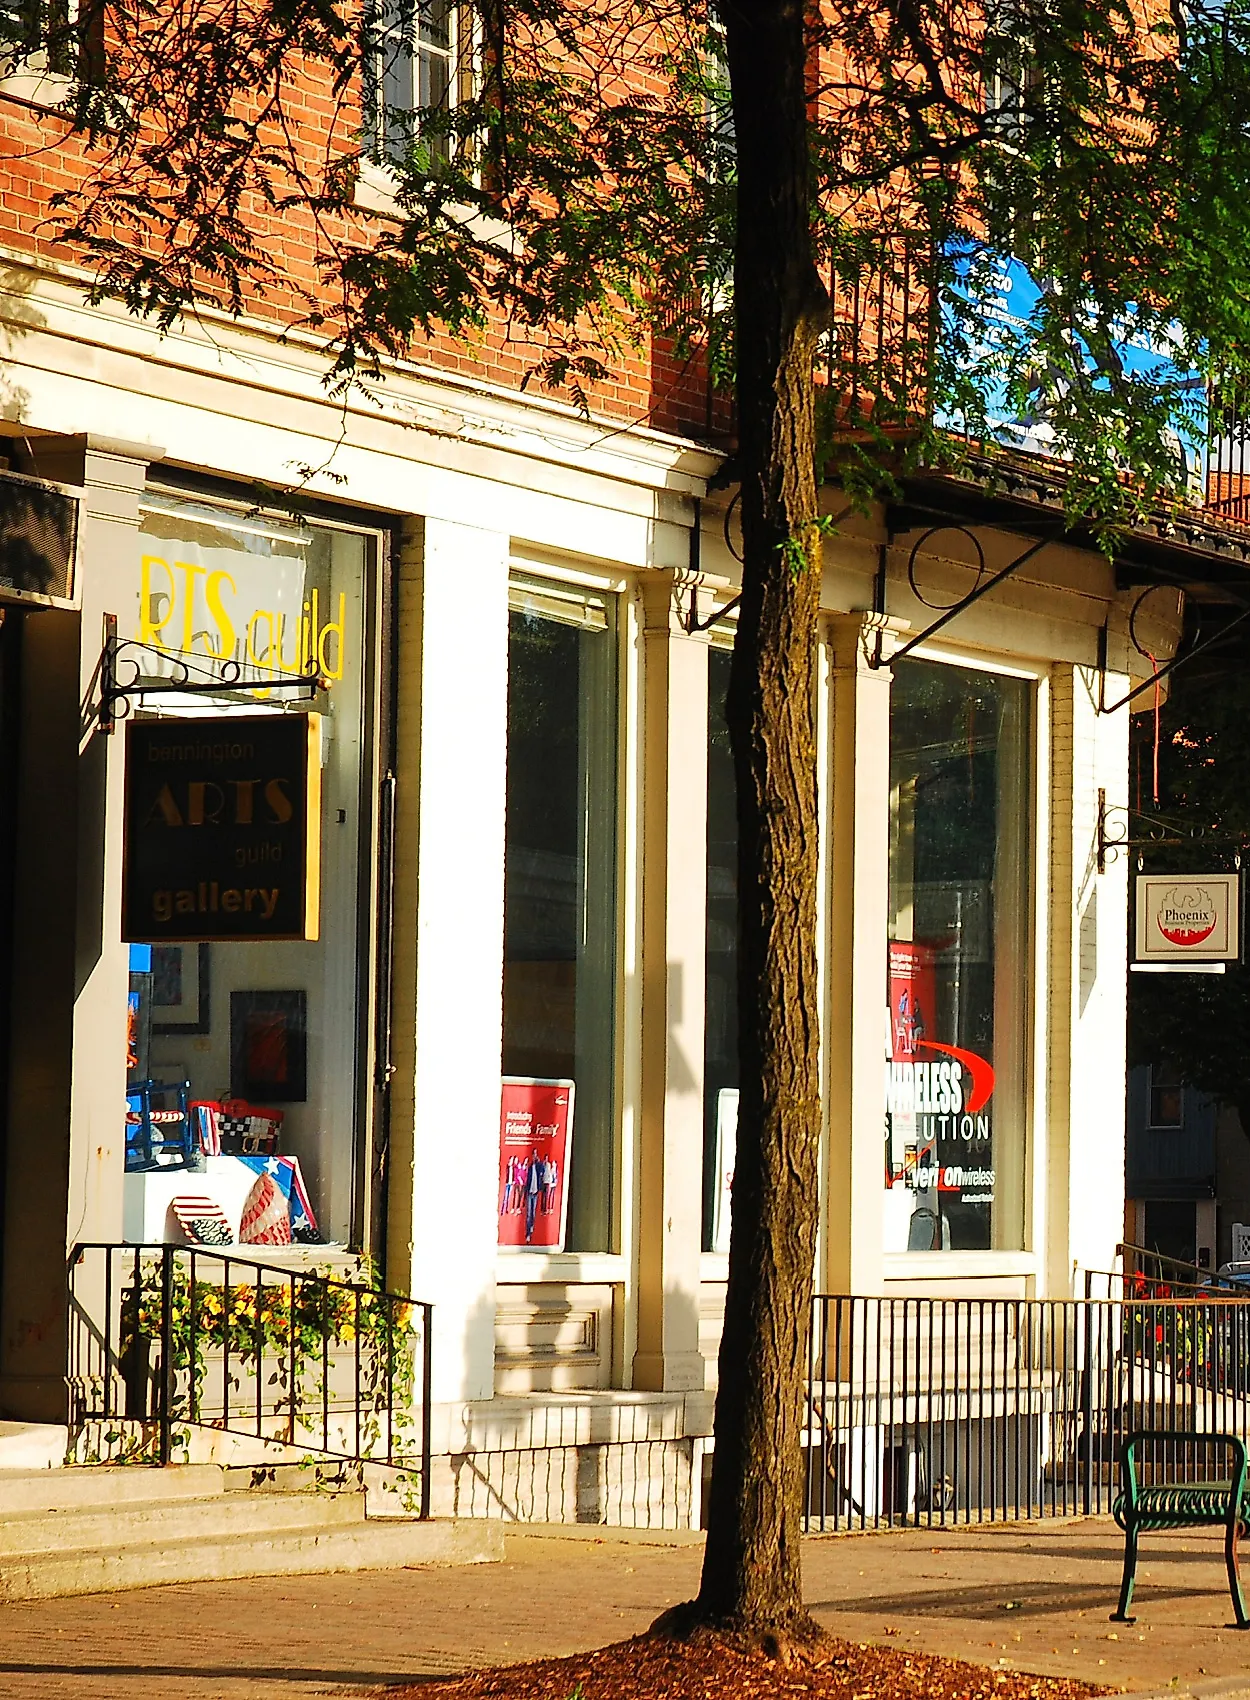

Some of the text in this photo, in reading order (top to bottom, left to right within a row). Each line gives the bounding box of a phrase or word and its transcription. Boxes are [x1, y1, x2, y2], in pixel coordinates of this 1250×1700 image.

[135, 554, 346, 700] RTS guild
[148, 741, 255, 764] bennington
[144, 778, 294, 827] ARTS
[235, 843, 283, 868] guild
[151, 881, 280, 923] gallery
[1164, 908, 1210, 921] Phoenix
[505, 1122, 532, 1135] Friends
